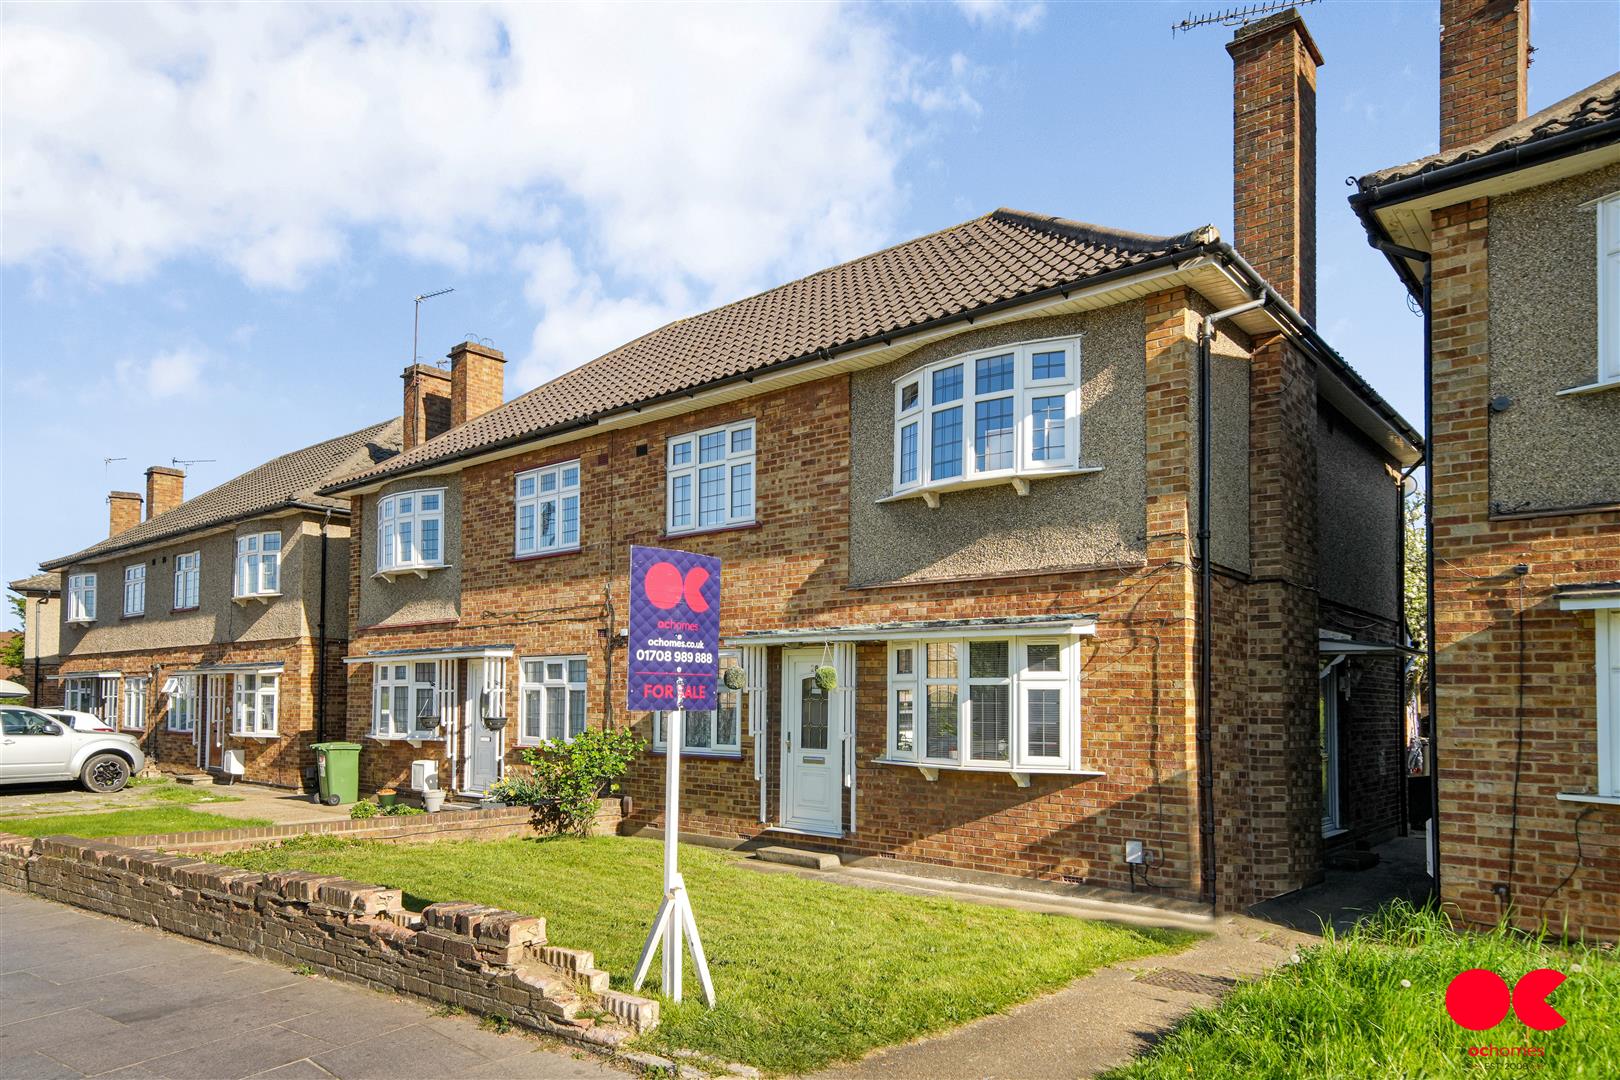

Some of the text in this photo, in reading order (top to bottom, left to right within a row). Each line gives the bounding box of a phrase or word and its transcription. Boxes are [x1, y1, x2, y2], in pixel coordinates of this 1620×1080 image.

[657, 618, 699, 631] ochomes
[648, 637, 705, 649] ochomes.co.uk
[636, 649, 713, 664] 01708 989 888
[644, 684, 674, 699] FOR
